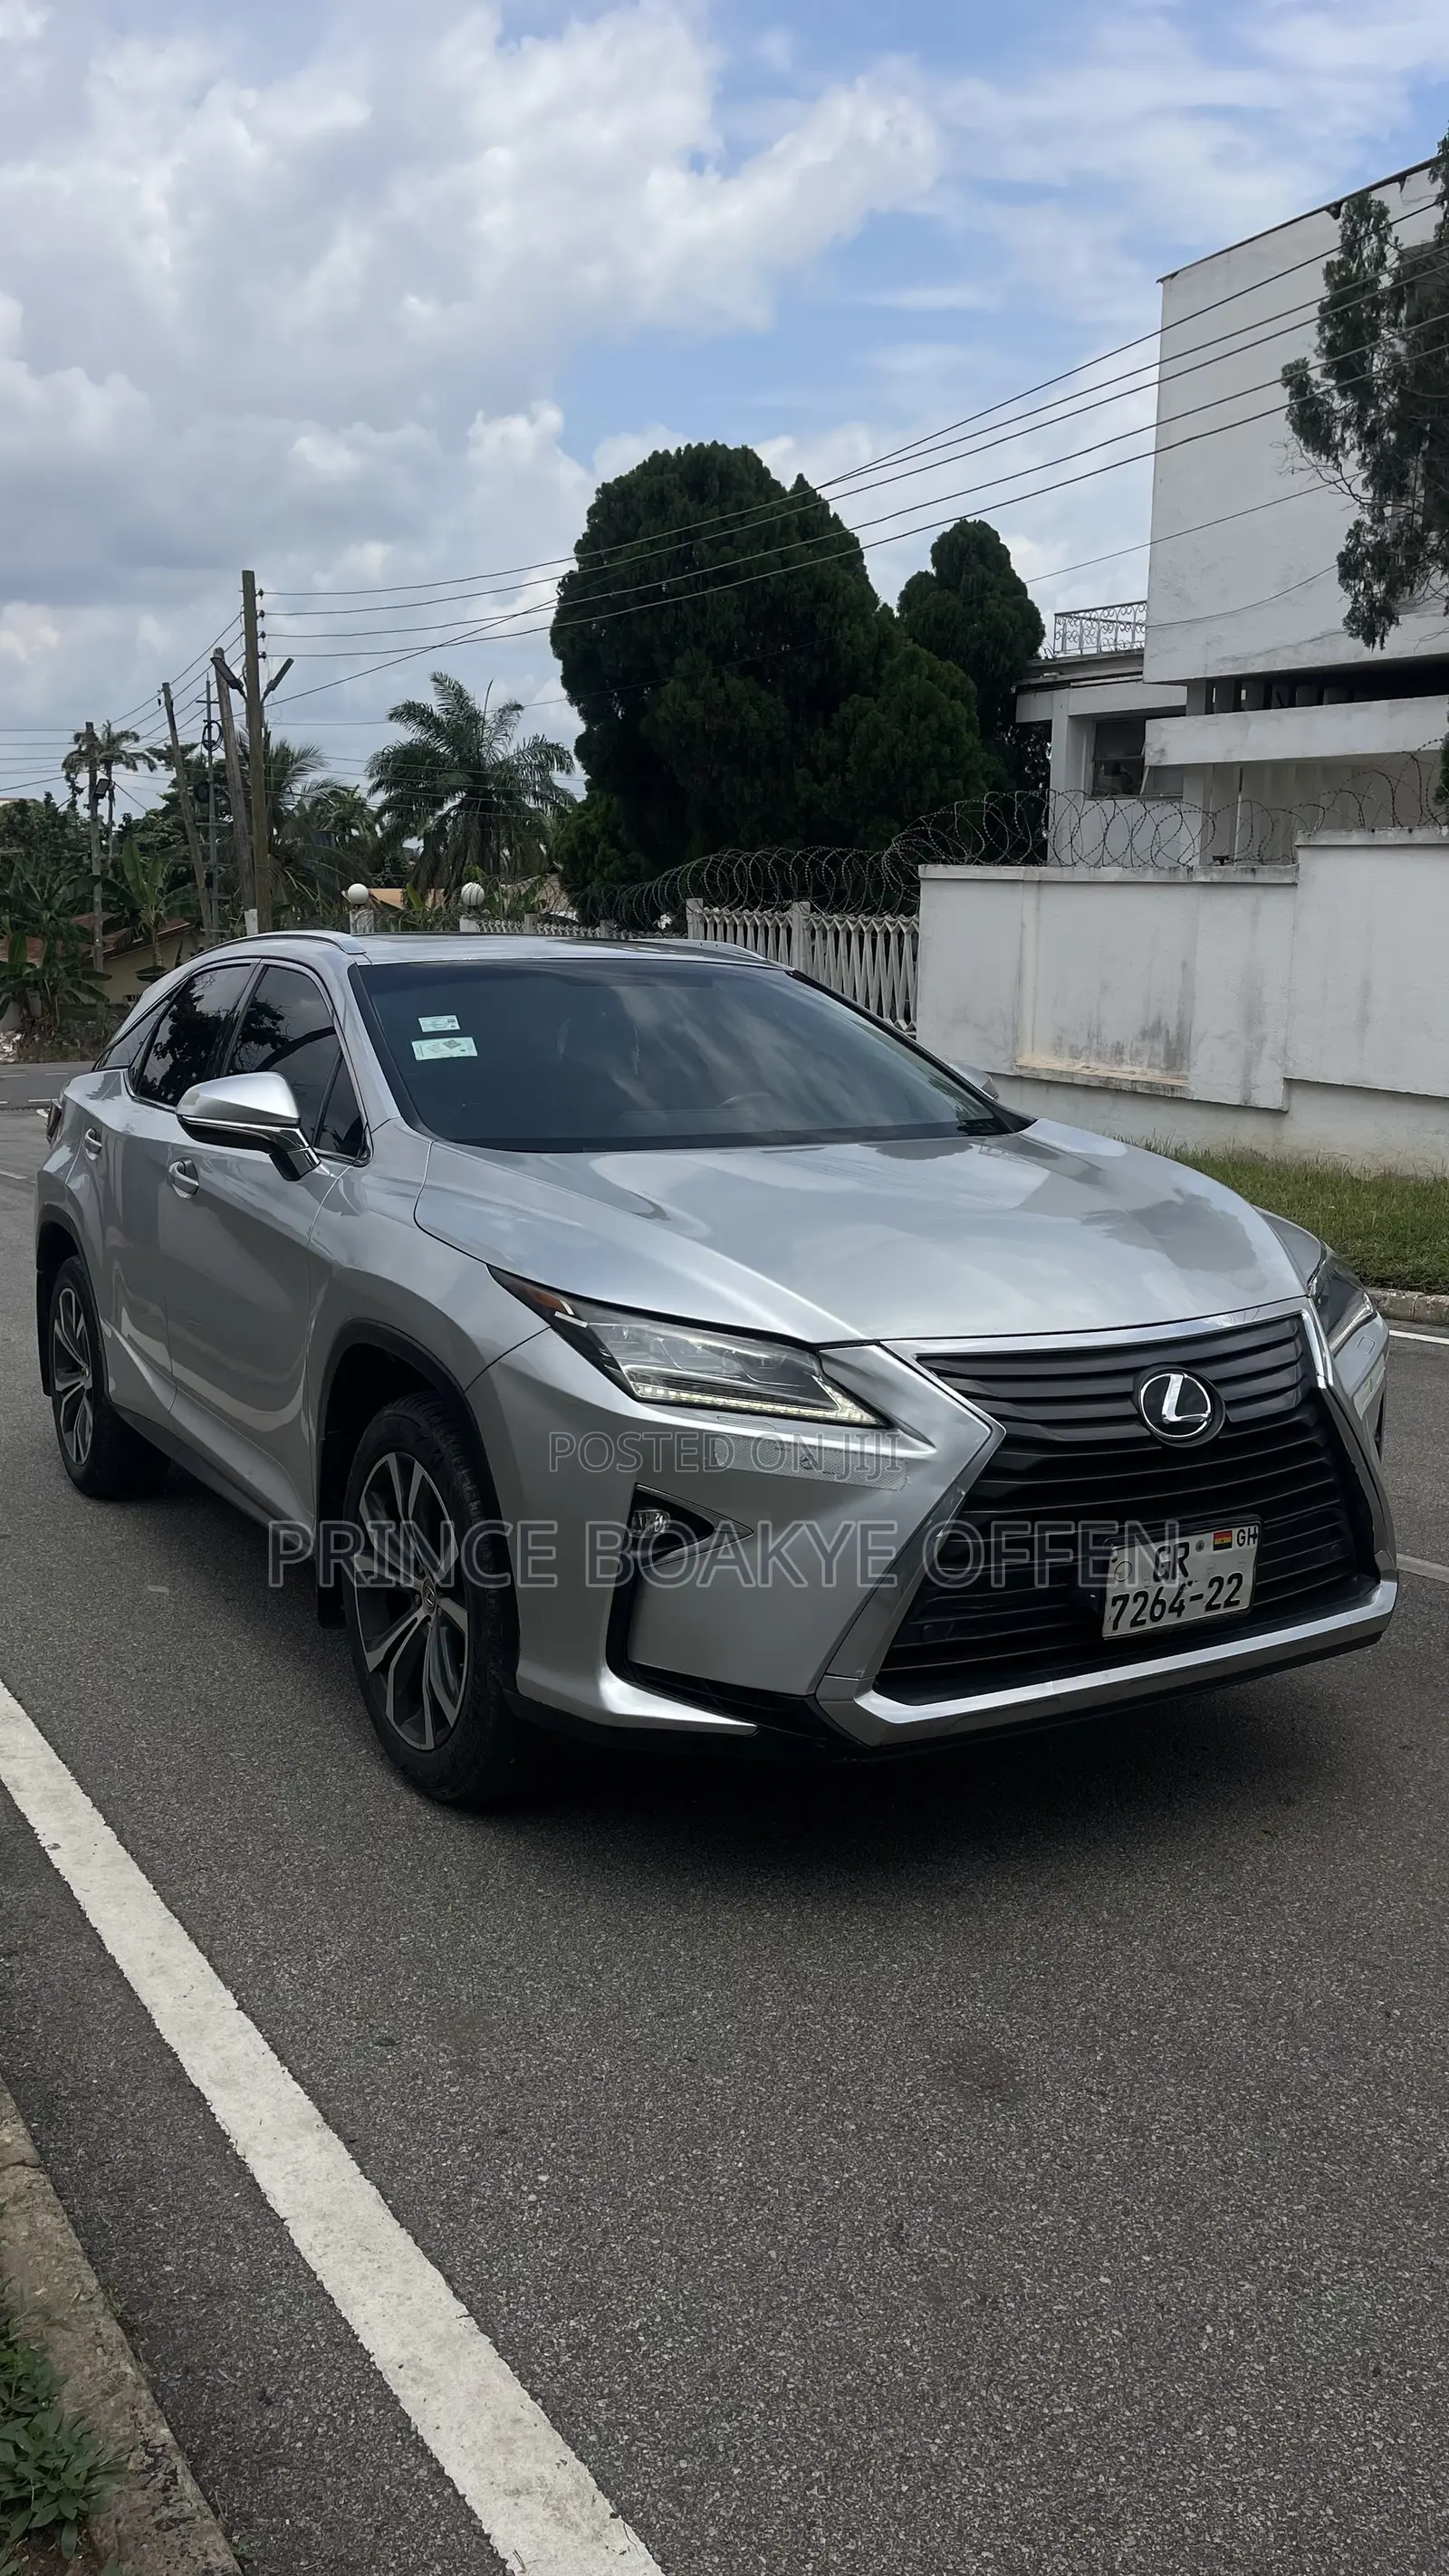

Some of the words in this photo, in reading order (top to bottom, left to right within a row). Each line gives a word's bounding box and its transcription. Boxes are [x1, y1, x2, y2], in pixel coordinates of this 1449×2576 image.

[1237, 1527, 1258, 1547] GH
[1153, 1541, 1190, 1584] GR
[1111, 1572, 1243, 1631] 7264-22
